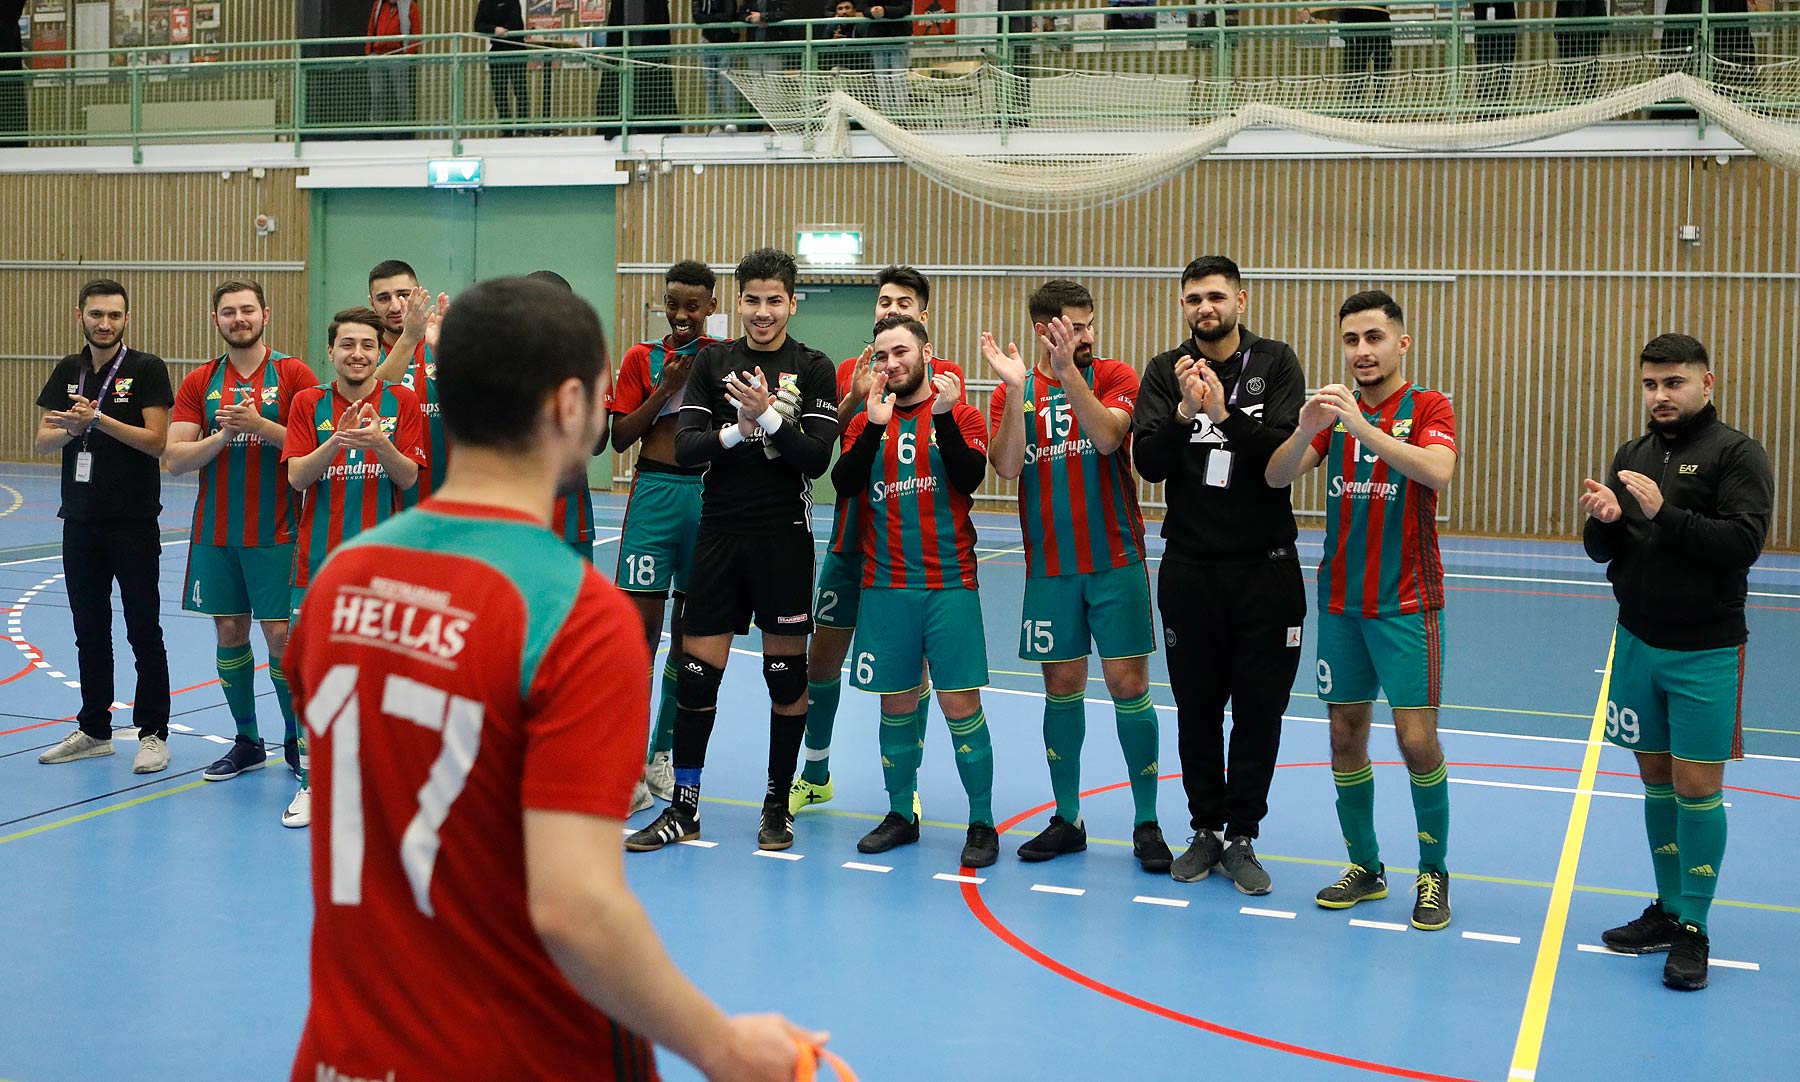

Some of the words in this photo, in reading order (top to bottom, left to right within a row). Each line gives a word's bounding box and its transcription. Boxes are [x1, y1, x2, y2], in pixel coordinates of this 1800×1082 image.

[1038, 403, 1073, 439] 15
[897, 432, 916, 465] 6
[1024, 437, 1093, 465] Spendrups
[320, 461, 386, 481] pendrup
[1679, 464, 1699, 473] EA7
[872, 476, 938, 502] Spendrups
[1328, 475, 1398, 498] Spendrups
[626, 554, 656, 586] 18
[192, 580, 202, 608] 4
[331, 594, 471, 659] HELLAS
[1023, 619, 1054, 654] 15
[856, 651, 876, 685] 6
[1605, 699, 1641, 744] 99
[304, 664, 487, 919] 17
